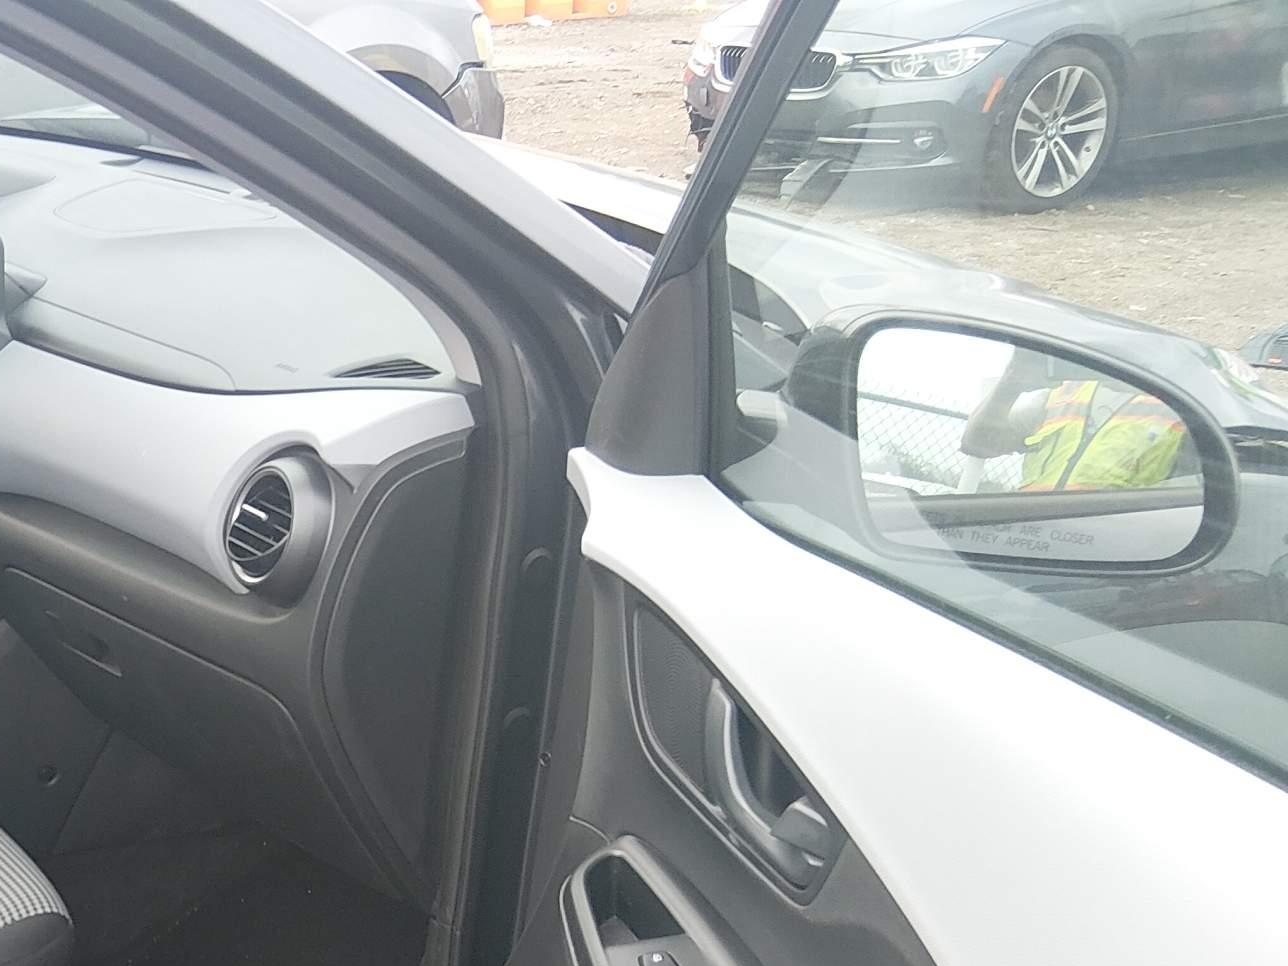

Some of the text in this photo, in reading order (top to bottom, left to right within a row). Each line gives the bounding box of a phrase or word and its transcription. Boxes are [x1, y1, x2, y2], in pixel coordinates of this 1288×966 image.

[971, 530, 999, 544] THEY
[1005, 537, 1051, 552] APPEAR
[1019, 525, 1043, 538] ARE
[1050, 529, 1095, 545] CLOSER
